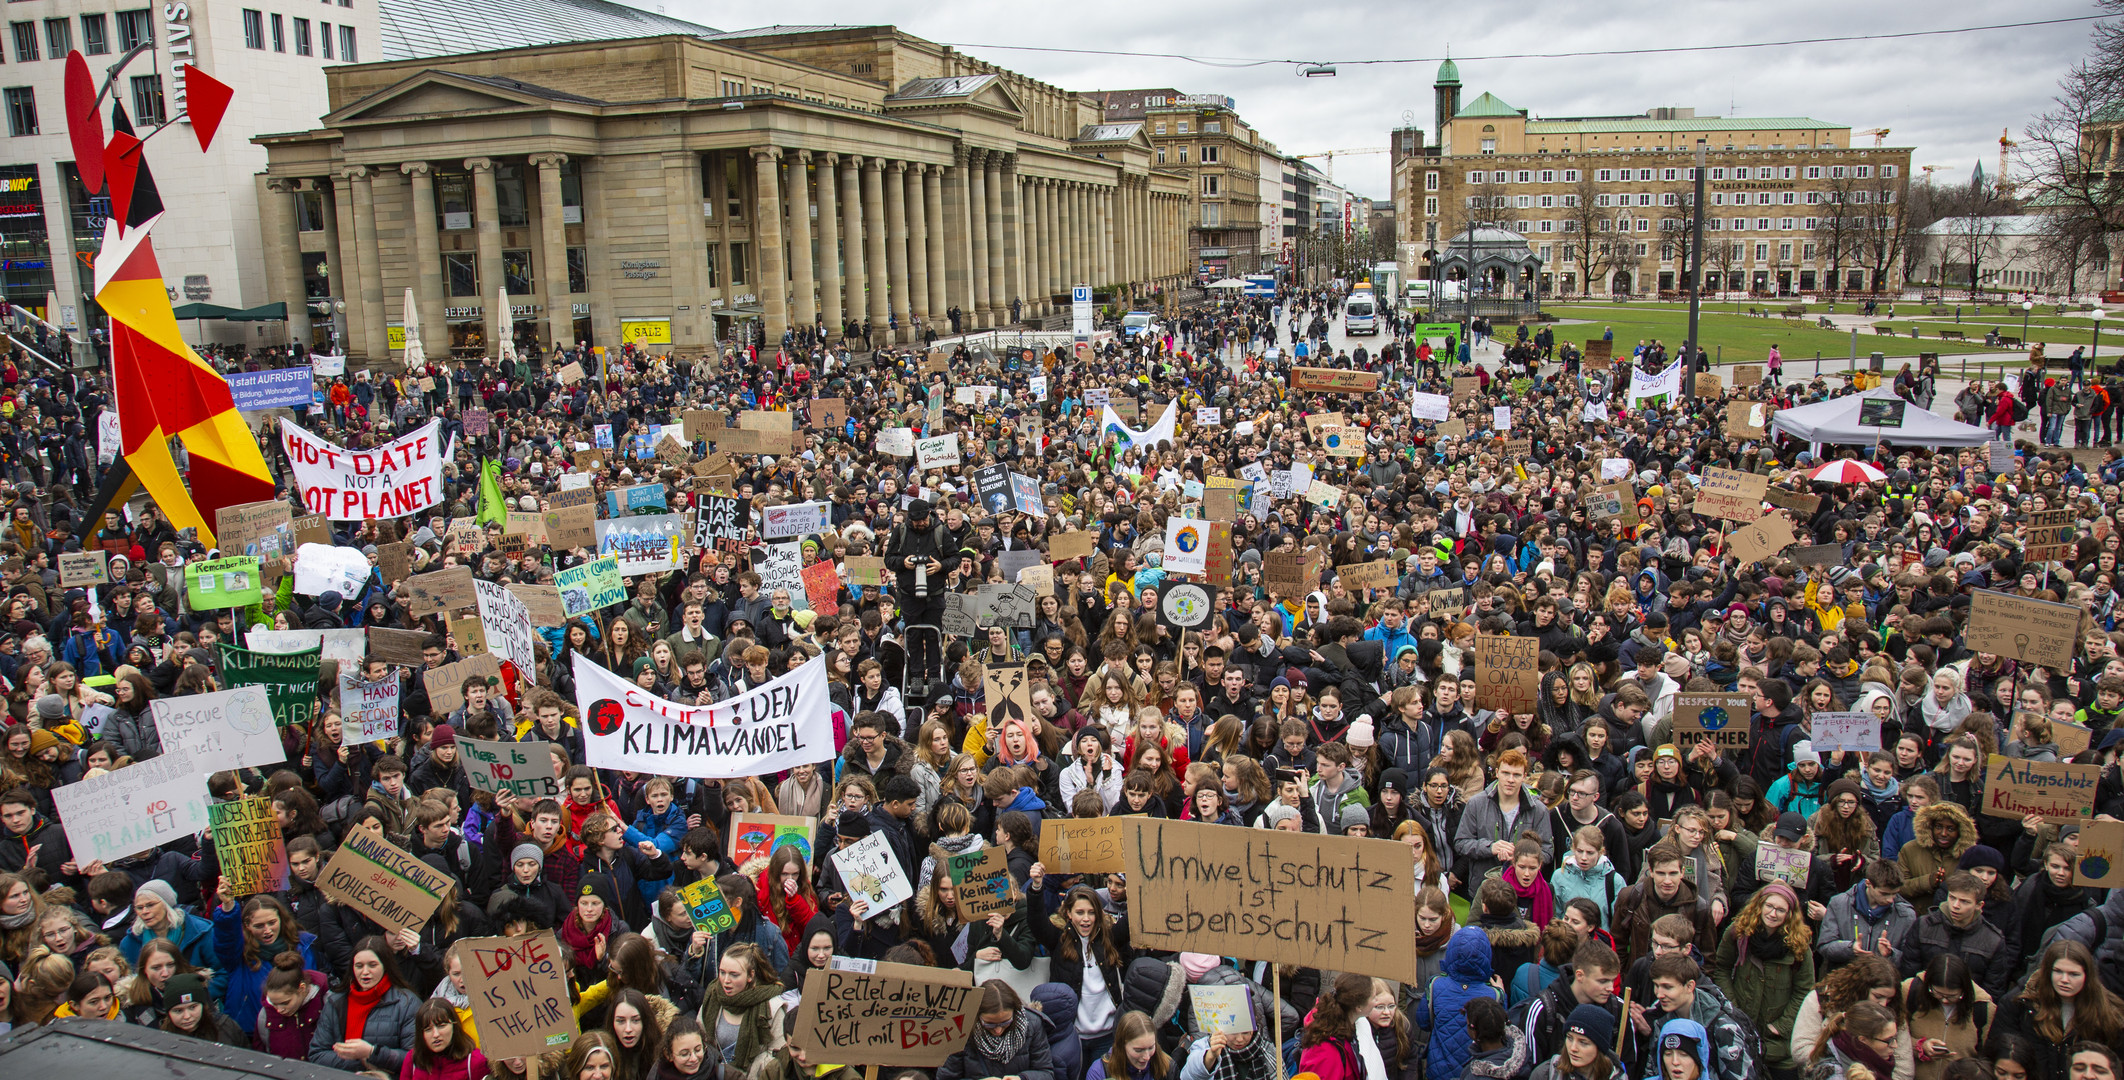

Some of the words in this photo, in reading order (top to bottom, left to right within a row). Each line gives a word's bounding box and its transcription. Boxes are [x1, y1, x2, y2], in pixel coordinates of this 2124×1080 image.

[1713, 182, 1742, 190] CARLS
[1745, 182, 1794, 190] BRAUHAUS
[624, 270, 658, 280] Passagen
[1076, 288, 1085, 299] U
[634, 327, 662, 337] SALE
[236, 375, 256, 387] statt
[258, 370, 309, 385] AUFRÜSTEN
[1300, 371, 1317, 380] Man
[1338, 373, 1357, 381] nicht
[239, 389, 264, 399] Bildung,
[265, 386, 301, 398] Wohnungen,
[289, 434, 340, 470] HOT
[352, 436, 429, 475] DATE
[699, 455, 726, 473] SCIENCE
[983, 467, 996, 476] FÜR
[345, 473, 376, 489] NOT
[382, 474, 392, 488] A
[980, 474, 1003, 485] UNSERE
[981, 480, 1007, 493] ZUKUNFT
[1207, 476, 1235, 488] SYSTEM
[343, 476, 432, 518] PLANET
[1019, 484, 1035, 495] NO
[1605, 493, 1615, 501] NO
[631, 495, 652, 505] STAND
[653, 492, 665, 500] FOR
[1024, 500, 1036, 514] B
[1586, 503, 1607, 513] PLANET
[510, 514, 531, 522] THERE
[532, 514, 539, 522] IS
[2030, 509, 2075, 526] THERE
[458, 530, 474, 540] WER
[697, 522, 748, 541] PLANET
[770, 522, 815, 535] KINDER!
[2028, 529, 2049, 545] IS
[497, 535, 523, 546] WANN
[694, 533, 713, 549] ON
[716, 537, 748, 554] FIRE
[224, 544, 244, 557] SUV
[778, 550, 798, 562] SURE
[2025, 546, 2058, 562] PLANET
[2061, 545, 2070, 559] B
[195, 559, 238, 573] Remember
[1266, 554, 1294, 566] NICHT
[553, 567, 587, 588] WINTER
[590, 557, 618, 577] COMING
[1268, 574, 1303, 583] ETWAS
[476, 580, 505, 599] MACHT
[592, 586, 625, 608] SNOW
[1970, 606, 1986, 615] THAN
[1988, 609, 1997, 617] MY
[1978, 594, 1996, 606] THE
[1997, 598, 2025, 612] EARTH
[2032, 607, 2057, 617] GETTING
[1980, 632, 2004, 640] PLANET
[2038, 635, 2049, 643] DO
[2051, 639, 2067, 647] NOT
[1478, 636, 1512, 655] THERE
[1513, 638, 1537, 658] ARE
[2028, 648, 2056, 658] CLIMATE
[2039, 643, 2063, 653] IGNORE
[1485, 654, 1504, 669] NO
[1504, 655, 1533, 671] JOBS
[2039, 657, 2065, 668] CHANGE
[424, 663, 459, 689] YOU
[462, 655, 496, 676] WANT
[1488, 669, 1509, 684] ON
[1510, 670, 1520, 685] A
[363, 683, 398, 702] HAND
[1482, 684, 1525, 700] DEAD
[361, 701, 380, 710] NOT
[431, 693, 453, 710] TO
[751, 683, 800, 723] DEN
[1479, 696, 1533, 714] PLANET
[1678, 696, 1722, 706] RESPECT
[1726, 698, 1748, 707] YOUR
[153, 700, 222, 729] Rescue
[350, 705, 398, 723] SECOND
[86, 716, 99, 732] NO
[161, 727, 192, 742] our
[623, 721, 806, 756] KLIMAWANDEL
[1680, 730, 1748, 746] MOTHER
[459, 740, 500, 764] There
[510, 749, 528, 765] is
[489, 762, 514, 780] NO
[1996, 761, 2095, 789] Artenschutz
[472, 771, 540, 797] PLANET
[540, 776, 560, 796] B
[146, 799, 168, 816] NO
[1991, 787, 2078, 818] Klimaschutz
[91, 808, 177, 854] PLANET
[1050, 823, 1096, 841] There's
[1100, 824, 1115, 836] no
[836, 848, 856, 864] We
[857, 833, 881, 856] stand
[1046, 841, 1092, 862] Planet
[1761, 845, 1807, 869] THC
[349, 831, 448, 893] UMWELTSCHUTZ
[856, 854, 867, 865] for
[955, 854, 989, 870] Ohne
[1136, 823, 1394, 893] Umweltschutz
[854, 860, 880, 880] What
[964, 867, 1008, 884] Bäume
[370, 870, 398, 891] statt
[851, 881, 868, 897] We
[874, 867, 898, 888] stand
[327, 867, 425, 931] KOHLESCHMUTZ
[872, 889, 888, 903] on
[1238, 882, 1284, 912] ist
[965, 896, 1014, 914] Träume
[1138, 884, 1389, 953] Lebensschutz
[474, 938, 549, 978] LOVE
[483, 986, 506, 1009] IS
[512, 975, 538, 1000] IN
[826, 973, 887, 1002] Rettet
[888, 980, 921, 1003] die
[924, 984, 973, 1013] WELT
[488, 1010, 534, 1039] THE
[533, 996, 565, 1030] AIR
[816, 1001, 836, 1024] Es
[836, 1000, 856, 1021] ist
[861, 1000, 888, 1018] die
[890, 1003, 948, 1025] einzige
[814, 1020, 861, 1049] Welt
[867, 1021, 895, 1046] mit
[901, 1013, 967, 1050] Bier!
[1569, 1025, 1585, 1035] FILA
